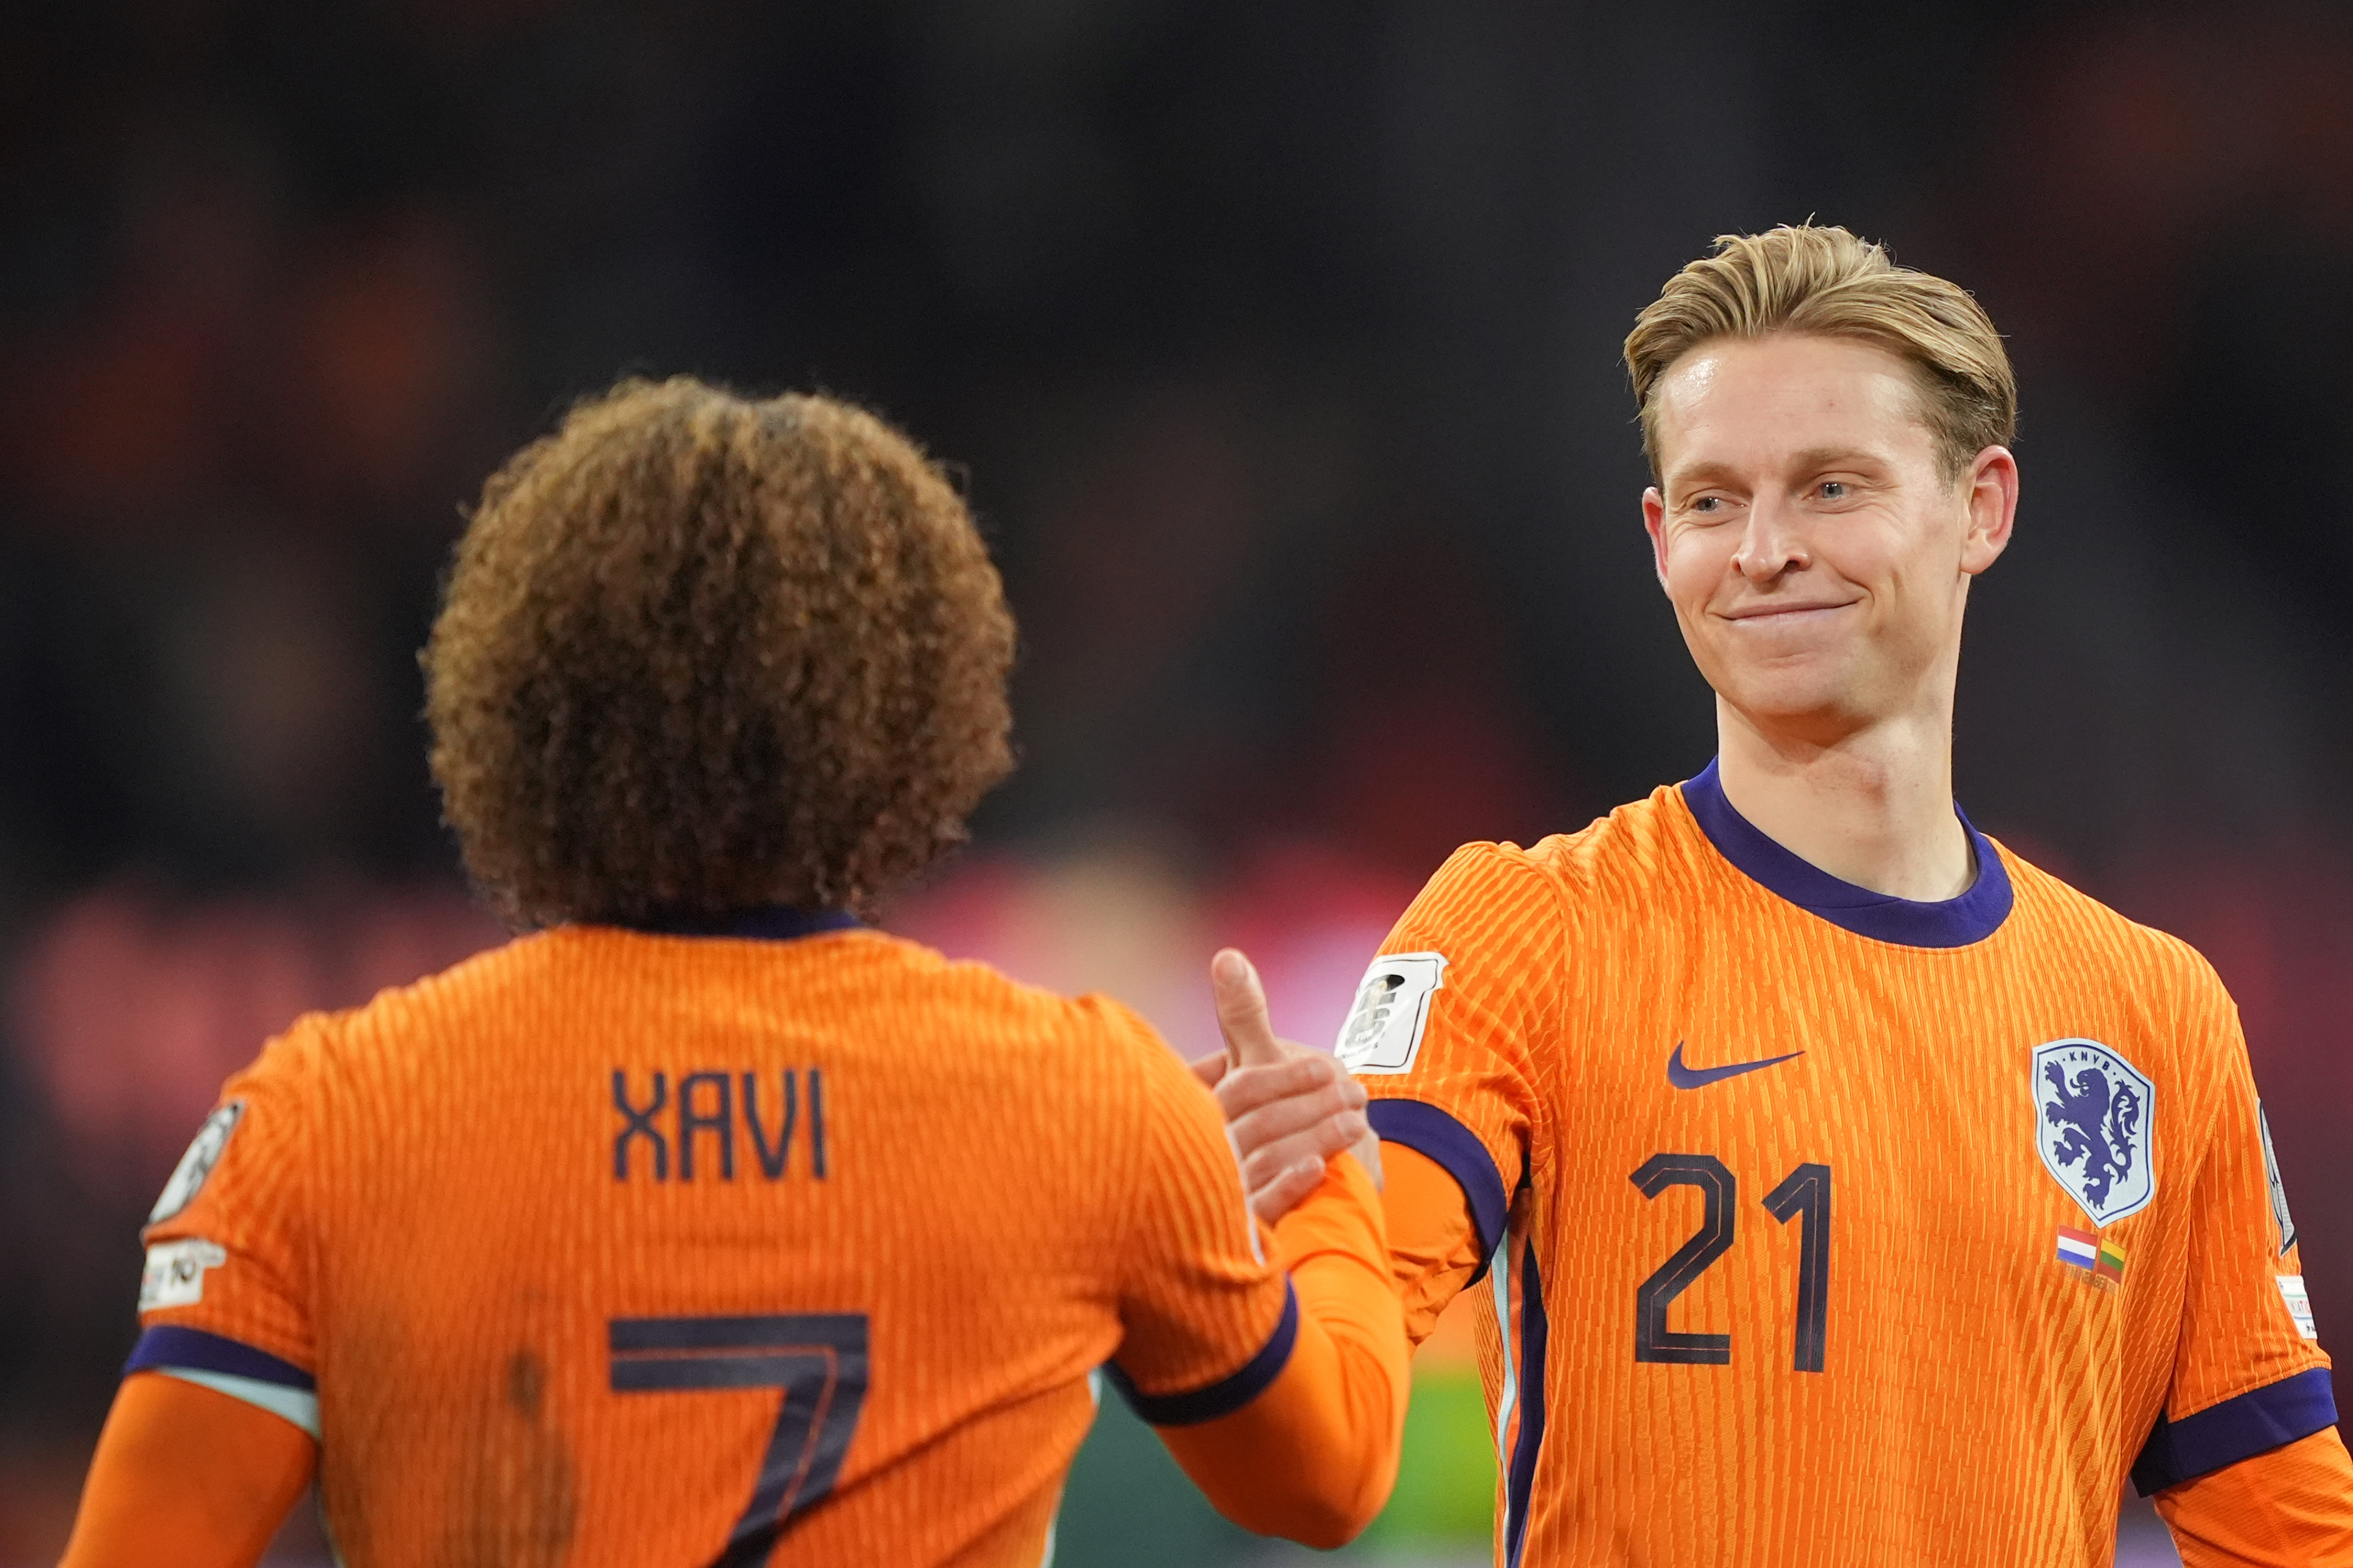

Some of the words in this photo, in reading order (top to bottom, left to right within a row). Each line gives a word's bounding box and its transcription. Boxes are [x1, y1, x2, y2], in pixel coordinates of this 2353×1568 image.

[612, 1069, 826, 1182] XAVI
[2069, 1051, 2110, 1071] KNVB
[1629, 1153, 1830, 1374] 21
[609, 1314, 869, 1568] 7
